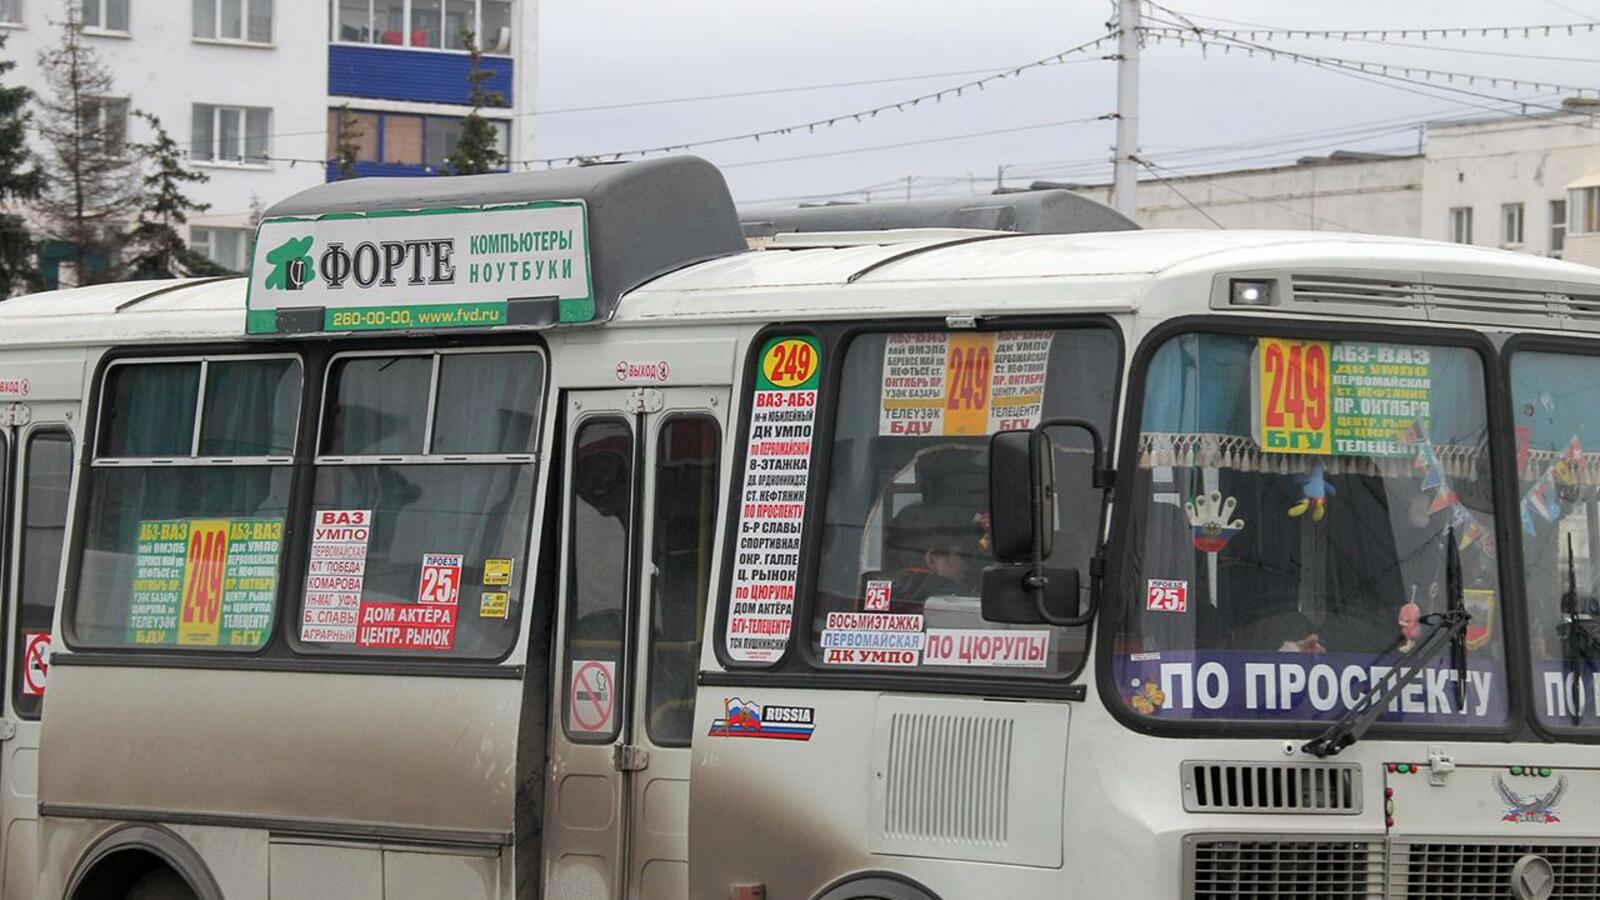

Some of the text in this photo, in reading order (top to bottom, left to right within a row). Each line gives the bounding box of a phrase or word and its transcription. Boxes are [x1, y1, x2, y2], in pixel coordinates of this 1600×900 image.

[470, 230, 572, 255] КОМПЬЮТЕРЫ
[319, 237, 456, 290] ФОРТЕ
[470, 259, 572, 283] НОУТБУКИ
[419, 308, 500, 324] www.fvd.ru
[1016, 341, 1048, 351] УМПО
[1332, 346, 1430, 364] АБЗ-ВАЗ
[771, 344, 811, 381] 249
[629, 364, 656, 379] ВЫХОД
[948, 346, 990, 411] 249
[885, 377, 929, 388] ОКТЯБРЬ
[1009, 373, 1044, 385] ОКТЯБРЯ
[1332, 375, 1430, 388] ПЕРВОМАЙСКАЯ
[908, 389, 941, 398] БАЗАРЫ
[1265, 343, 1326, 431] 249
[756, 392, 815, 407] ВАЗ-АБЗ
[991, 405, 1040, 417] ТЕЛЕЦЕНТР
[1335, 398, 1430, 416] ПР. ОКТЯБРЯ
[753, 425, 812, 439] ДК УМПО
[891, 421, 932, 435] БДУ
[1000, 419, 1030, 431] БГУ
[1267, 431, 1324, 449] БГУ
[1336, 440, 1424, 455] ТЕЛЕЦЕНТ
[750, 459, 807, 470] 8-ЭТАЖКА
[746, 490, 804, 502] СТ. НЕФТЯНИК
[322, 512, 364, 524] ВАЗ
[744, 504, 803, 518] ПО ПРОСПЕКТУ
[316, 529, 367, 540] УМПО
[742, 522, 801, 533] Б-Р СЛАВЫ
[741, 538, 799, 549] СПОРТИВНАЯ
[428, 557, 458, 566] ПРОЕЗД
[739, 553, 798, 565] ОКР. ГАЛЛЕ
[182, 529, 227, 624] 249
[738, 569, 796, 581] Ц. РЫНОК
[309, 578, 360, 589] КОМАРОВА
[751, 585, 793, 600] ЦЮРУПА
[338, 594, 358, 607] УФА
[363, 606, 451, 623] ДОМ АКТЁРА
[734, 602, 792, 615] ДОМ АКТЁРА
[318, 611, 358, 624] СЛАВЫ
[829, 614, 919, 630] ВОСЬМИЭТАЖКА
[732, 618, 791, 636] БГУ-ТЕЛЕЦЕНТР
[303, 629, 356, 640] АГРАРНЫЙ
[361, 627, 450, 646] ЦЕНТР. РЫНОК
[824, 633, 919, 648] ПЕРВОМАЙСКАЯ
[927, 635, 1046, 664] ПО ЦЮРУПЫ
[828, 650, 914, 664] ДК УМПО
[1160, 662, 1492, 716] ПО ПРОСПЕКТУ
[1543, 671, 1585, 718] ПО
[766, 707, 811, 722] RUSSIA
